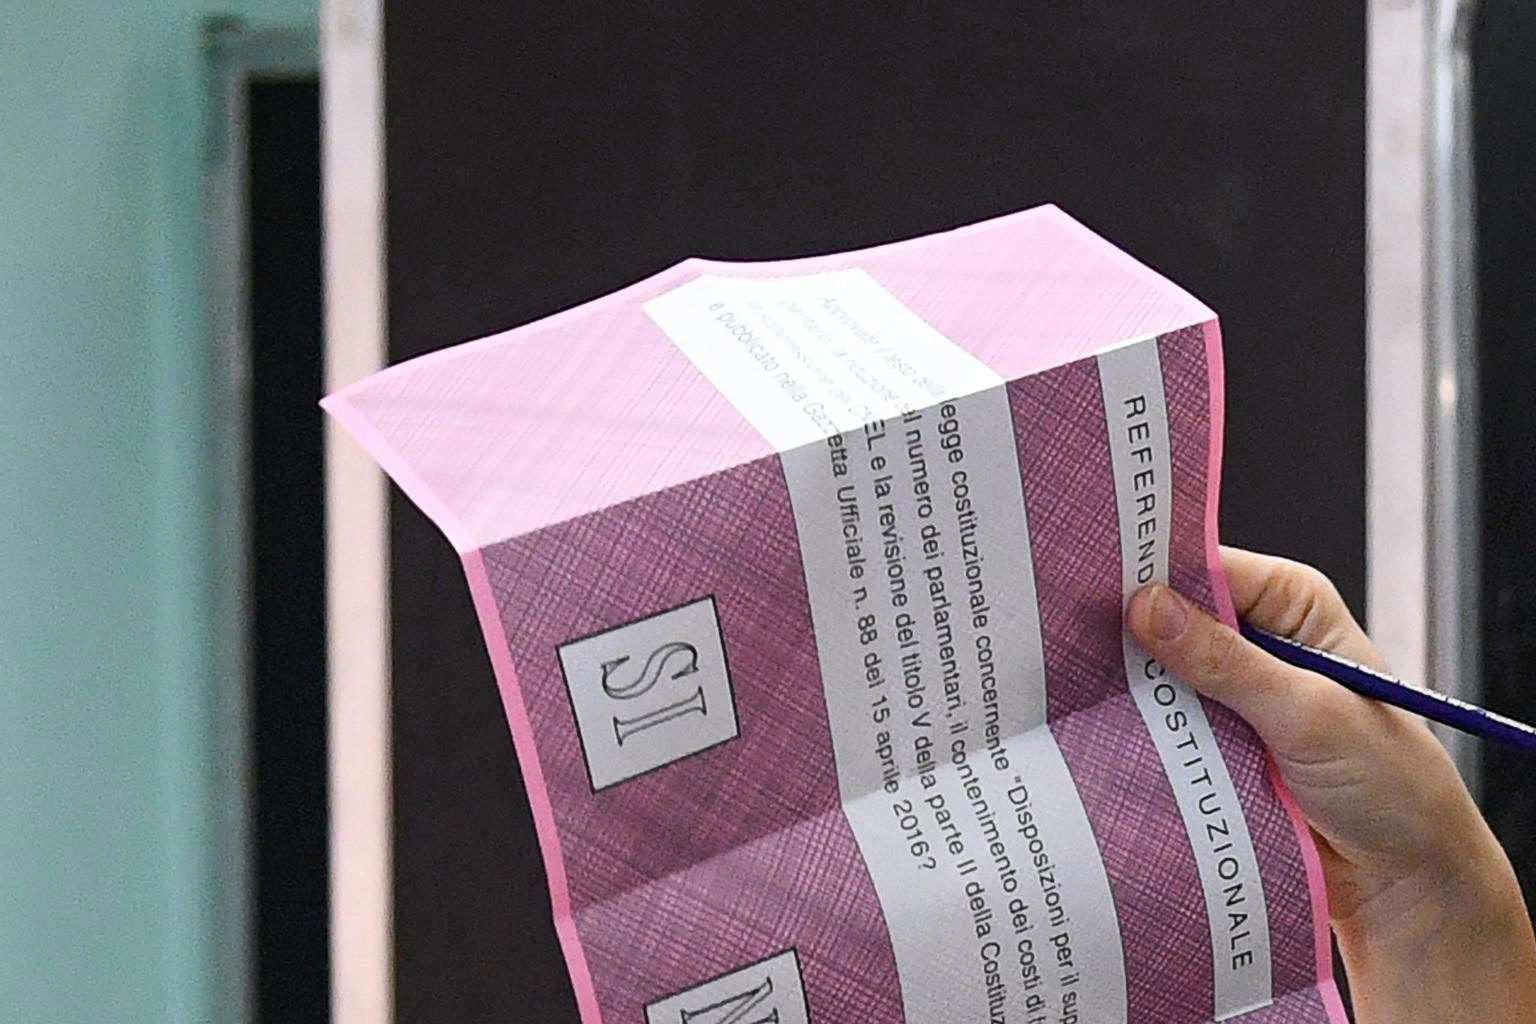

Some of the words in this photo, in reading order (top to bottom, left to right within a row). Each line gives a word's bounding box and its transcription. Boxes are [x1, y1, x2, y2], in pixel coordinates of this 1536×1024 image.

[870, 456, 887, 471] e
[873, 474, 893, 499] la
[905, 429, 933, 519] numero
[1124, 394, 1156, 584] REFEREND
[837, 485, 868, 579] Ufficiale
[878, 503, 908, 607] revisione
[920, 525, 945, 560] dei
[951, 470, 992, 629] costituzionale
[853, 586, 870, 610] n.
[857, 614, 878, 645] 88
[895, 612, 920, 649] del
[923, 565, 968, 718] parlamentari,
[600, 641, 708, 747] SI
[863, 651, 886, 689] del
[901, 653, 927, 709] titolo
[871, 696, 891, 724] 15
[911, 711, 932, 729] V
[949, 721, 969, 736] il
[975, 634, 1010, 771] concernente
[875, 731, 903, 794] aprile
[914, 736, 938, 789] della
[892, 798, 937, 870] 2016?
[925, 793, 966, 856] parte
[951, 738, 1018, 893] contenimento
[957, 858, 978, 876] II
[965, 881, 993, 938] della
[1008, 897, 1034, 936] dei
[1017, 939, 1043, 991] costi
[1049, 932, 1074, 970] per
[1025, 994, 1046, 1015] di
[1060, 972, 1080, 987] il
